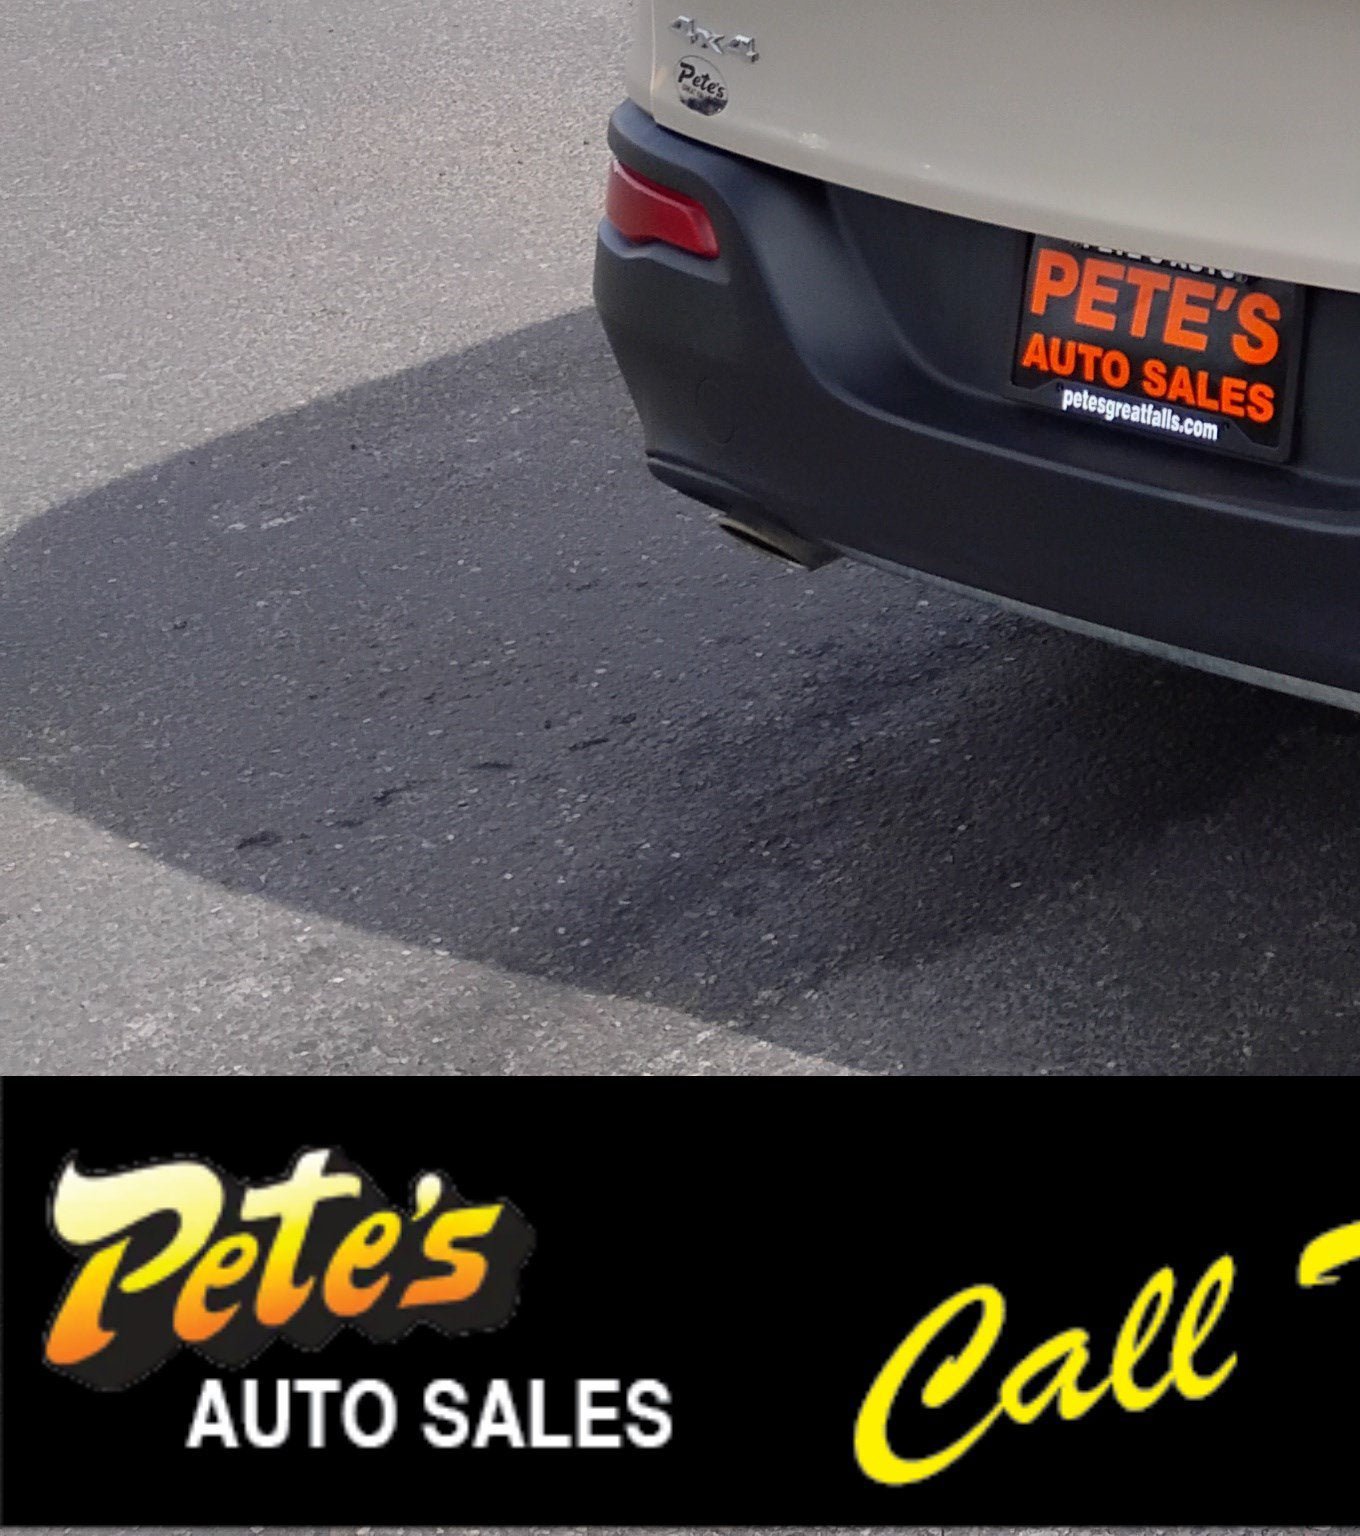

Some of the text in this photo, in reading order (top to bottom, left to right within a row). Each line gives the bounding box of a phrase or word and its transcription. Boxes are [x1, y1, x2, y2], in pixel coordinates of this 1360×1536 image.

[677, 61, 726, 99] Pete's
[1030, 248, 1281, 366] PETE'S
[1021, 332, 1276, 424] AUTO SALES
[1060, 386, 1219, 442] petesgreatfalls.com
